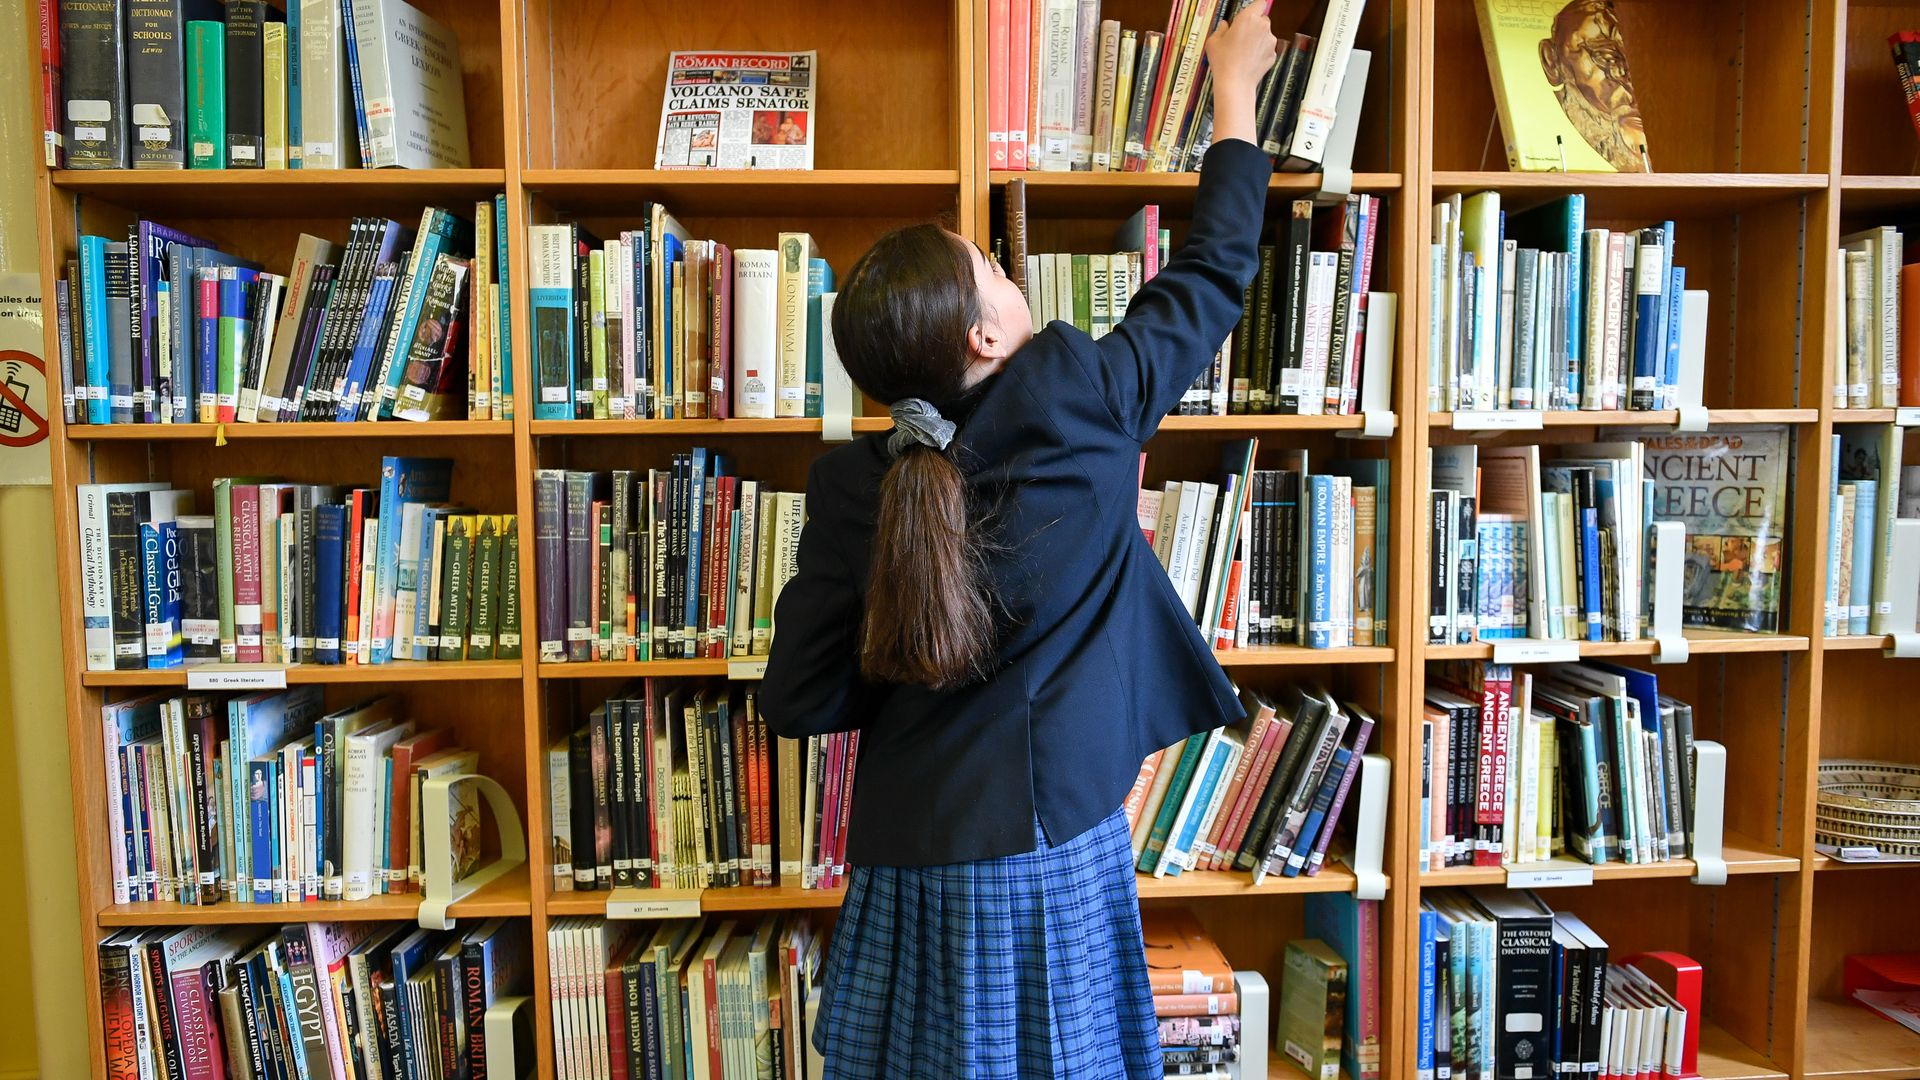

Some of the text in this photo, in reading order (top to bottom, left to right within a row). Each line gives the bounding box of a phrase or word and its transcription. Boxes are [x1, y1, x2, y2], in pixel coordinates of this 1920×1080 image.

[131, 8, 174, 18] DICTIONARY
[132, 31, 172, 40] SCHOOLS
[674, 58, 788, 70] ROMAN RECORD
[1050, 12, 1061, 78] CIVILIZATION
[1060, 26, 1070, 63] ROMAN
[671, 86, 753, 98] VOLCANO
[1101, 34, 1116, 108] GLADIATOR
[1163, 31, 1200, 136] THE ROMAN WORLD
[669, 98, 810, 110] CLAIMS SENATOR
[542, 233, 550, 258] ROMAN
[552, 233, 560, 262] BRITAIN
[1015, 210, 1025, 245] ROME
[1364, 234, 1375, 273] ANCIENT
[128, 234, 140, 338] ROMAN MYTHOLOGY
[332, 288, 341, 308] GREEK
[1094, 270, 1108, 312] ROME
[1114, 270, 1127, 312] ROME
[1330, 250, 1352, 364] LIFE ANCIENT ROME
[1608, 279, 1622, 336] ANCIENT
[320, 310, 336, 341] MYTHOLOGY
[330, 310, 346, 341] MYTHOLOGY
[340, 288, 360, 341] GREEK MYTHOLOGY
[349, 310, 364, 341] MYTHOLOGY
[377, 274, 414, 388] ROMAN MYTHOLOGY
[784, 278, 798, 352] LONDINIVM
[1302, 302, 1318, 374] ANCIENT ROME
[1884, 296, 1895, 368] KING ARTHUR
[672, 478, 680, 510] Introduction
[1644, 455, 1766, 481] NCIENT
[87, 494, 95, 520] Grimal
[692, 500, 700, 532] ROMANS
[743, 494, 753, 572] ROMAN WOMAN
[791, 499, 802, 538] LIFE AND
[1316, 486, 1327, 566] ROMAN EMPIRE
[234, 526, 242, 574] RELIGION
[242, 500, 252, 582] CLASSICAL MYTH
[655, 520, 666, 598] The Viking World
[760, 498, 770, 588] Xenophon Anderson
[780, 546, 788, 586] BALSDON
[1174, 536, 1186, 564] Romans
[1192, 538, 1204, 566] Romans
[84, 528, 96, 608] Classical Mythology
[120, 557, 128, 618] Classical Mythology
[145, 538, 161, 624] Classical Gree
[450, 562, 460, 626] GREEK MYTHS
[479, 561, 490, 624] GREEK MYTHS
[507, 593, 516, 624] MYTHS
[323, 732, 334, 778] Odyssey
[614, 722, 624, 802] The Complete Pompeii
[736, 728, 744, 754] WOMEN
[759, 724, 768, 777] ENCYCLOPEDIA
[1235, 718, 1266, 782] COLOSSEUM
[1311, 729, 1334, 774] ARENA
[1480, 691, 1495, 811] ANCIENT GREECE
[1492, 691, 1510, 811] ANCIENT GREECE
[632, 736, 642, 802] Complete Pompeii
[657, 768, 666, 810] DISCOVERING
[690, 770, 701, 818] Roman Britain
[748, 724, 761, 836] ENCYCLOPEDIA ROMAN
[1334, 733, 1367, 808] PLINY THE YOUNGER
[1501, 938, 1551, 947] CLASSICAL
[1502, 930, 1551, 938] THE OXFORD
[1502, 947, 1550, 955] DICTIONARY
[132, 954, 142, 996] SHOCK HORROR
[150, 948, 172, 1040] SPORTS and GAMES
[282, 983, 292, 1011] CLEOPATRA
[466, 966, 483, 1028] ROMAN
[180, 990, 197, 1064] CIVILIZATION
[190, 989, 208, 1062] CLASSICAL
[238, 968, 262, 1072] ATLAS CLASSICAL HISTORY
[291, 972, 325, 1044] EGYPT
[358, 962, 378, 1064] PEOPLE PHARAOHS
[384, 999, 400, 1048] MASADA
[628, 978, 640, 1054] ANCIENT ROME
[1420, 941, 1433, 1069] Greek and Roman Technology
[646, 1016, 656, 1050] ROMANS
[662, 1013, 670, 1065] BARBARIANS
